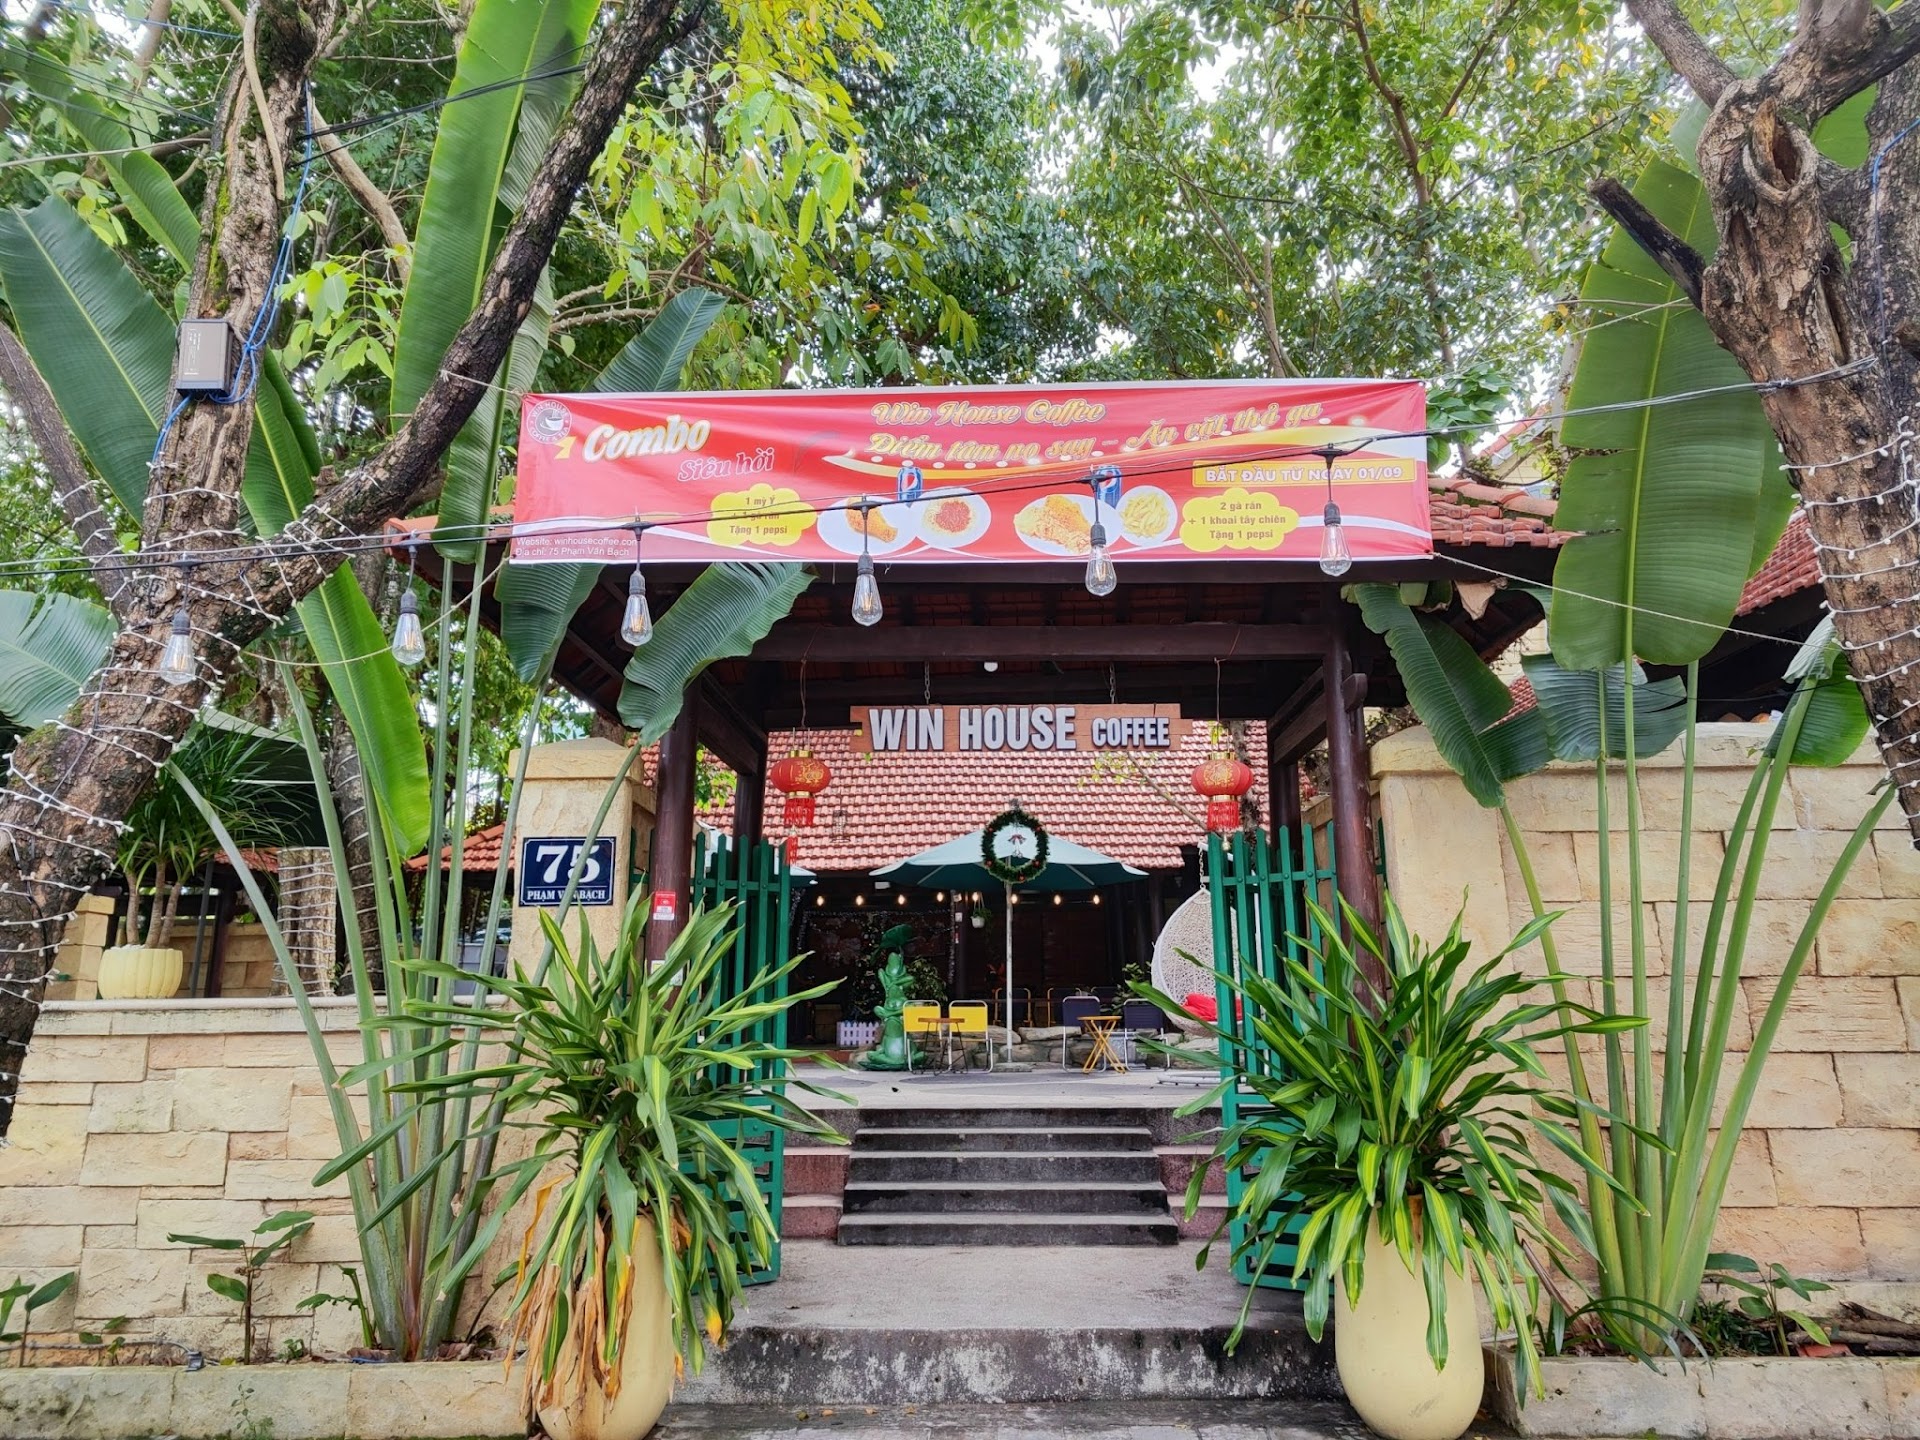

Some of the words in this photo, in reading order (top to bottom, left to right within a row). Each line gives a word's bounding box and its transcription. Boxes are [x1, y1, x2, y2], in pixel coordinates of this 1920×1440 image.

[532, 404, 543, 417] WIN
[871, 402, 932, 425] Win
[935, 400, 1022, 427] House
[1025, 399, 1106, 426] Coffee
[583, 414, 711, 463] Combo
[1003, 442, 1041, 462] no
[1045, 437, 1097, 461] say
[1126, 418, 1179, 448] Ăn
[1231, 402, 1280, 433] thả
[1284, 402, 1324, 429] ga
[677, 457, 732, 482] Siêu
[1206, 465, 1237, 482] BẮT
[1241, 464, 1276, 482] ĐẦU
[1282, 466, 1304, 481] TỪ
[1309, 465, 1353, 481] NGÀY
[1357, 466, 1403, 481] 01/09
[745, 497, 750, 505] 1
[1220, 502, 1227, 510] 2
[1230, 502, 1242, 513] gà
[1201, 517, 1206, 525] 1
[1209, 516, 1238, 525] khoai
[1240, 516, 1256, 526] tây
[1258, 515, 1286, 524] chiên
[729, 525, 752, 535] Tặng
[756, 526, 760, 534] 1
[763, 525, 788, 535] pepsi
[1209, 530, 1234, 541] Tặng
[1238, 531, 1243, 539] 1
[1247, 530, 1273, 541] pepsi
[549, 547, 559, 556] 75
[561, 547, 585, 557] Phạm
[607, 547, 629, 557] Bạch
[869, 707, 944, 750] WIN
[959, 707, 1077, 750] HOUSE
[1091, 717, 1170, 747] COFFEE
[536, 845, 600, 883] 75
[527, 889, 556, 902] PHẠM
[580, 889, 606, 902] BẠCH
